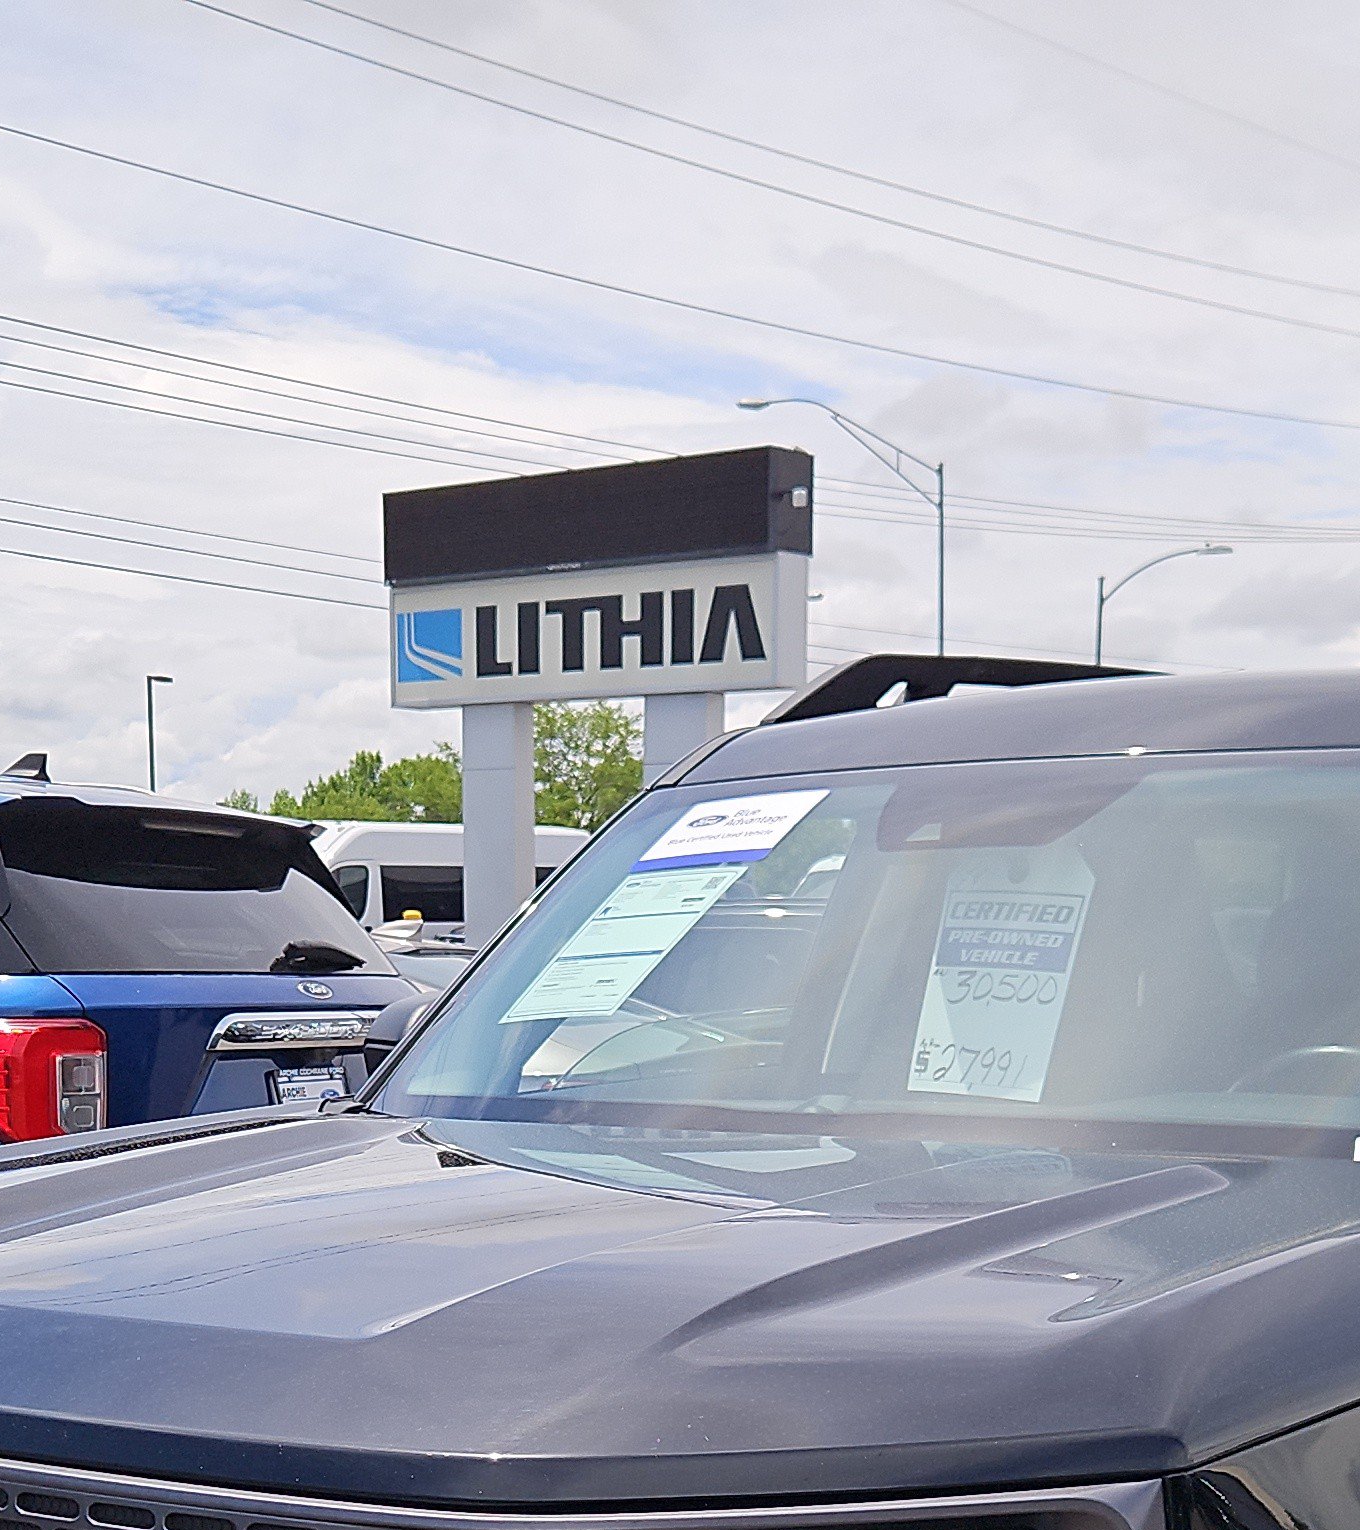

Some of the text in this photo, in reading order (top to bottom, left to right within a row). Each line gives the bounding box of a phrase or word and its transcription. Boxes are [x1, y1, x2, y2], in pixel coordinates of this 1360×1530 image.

[475, 584, 767, 678] LITHIA
[724, 815, 787, 827] Advantage
[950, 901, 1076, 925] CERTIFIED
[947, 930, 1066, 948] PRE-OWNED
[959, 949, 1040, 966] VEHICLE
[282, 1086, 307, 1099] ARCHIE
